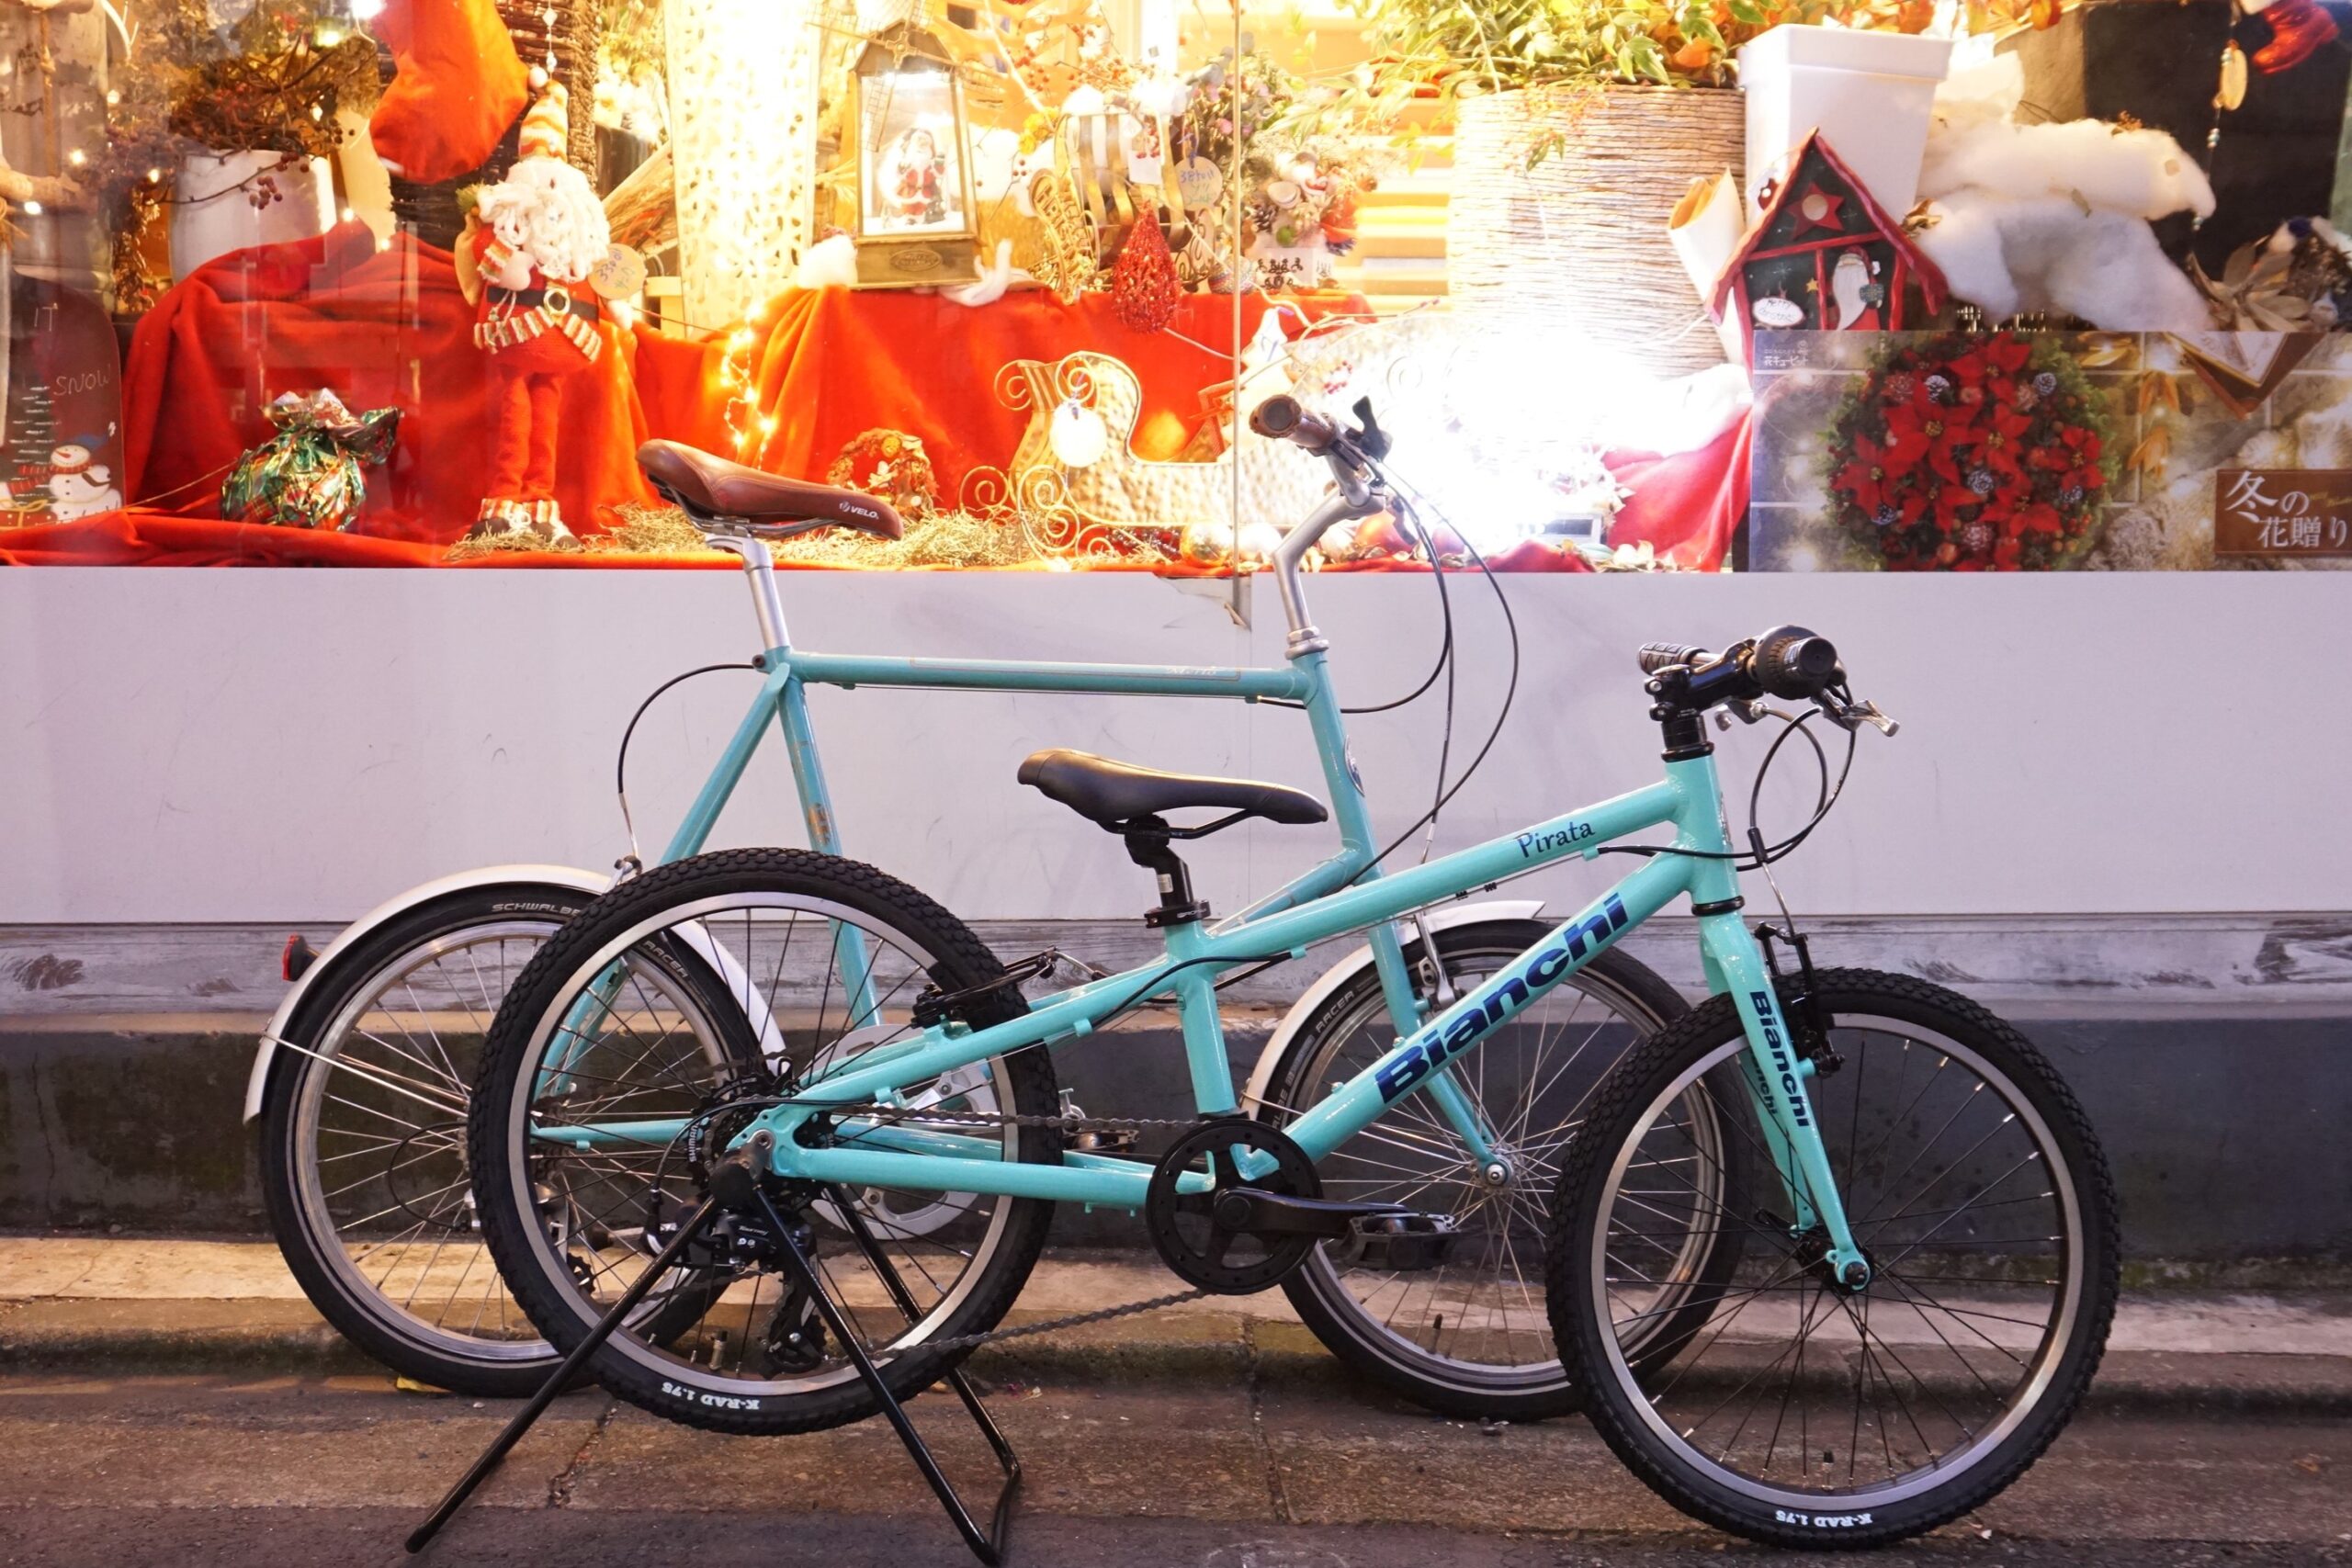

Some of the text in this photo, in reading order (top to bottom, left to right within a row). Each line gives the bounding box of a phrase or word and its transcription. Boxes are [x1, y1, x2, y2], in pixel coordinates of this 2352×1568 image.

[851, 505, 878, 519] VELO
[2224, 469, 2310, 524] 冬の
[2257, 516, 2347, 548] 花贈り
[1514, 821, 1596, 858] Pirata
[492, 902, 581, 917] SCHWALBE
[644, 940, 688, 978] RACER
[1315, 990, 1354, 1033] RACER
[1374, 892, 1629, 1104] Bianchi
[1749, 991, 1810, 1127] Bianchi
[688, 1122, 700, 1163] SHIMAN
[662, 1382, 761, 1410] K-RAD 1.75
[1775, 1509, 1873, 1527] K-RAD 1.75
